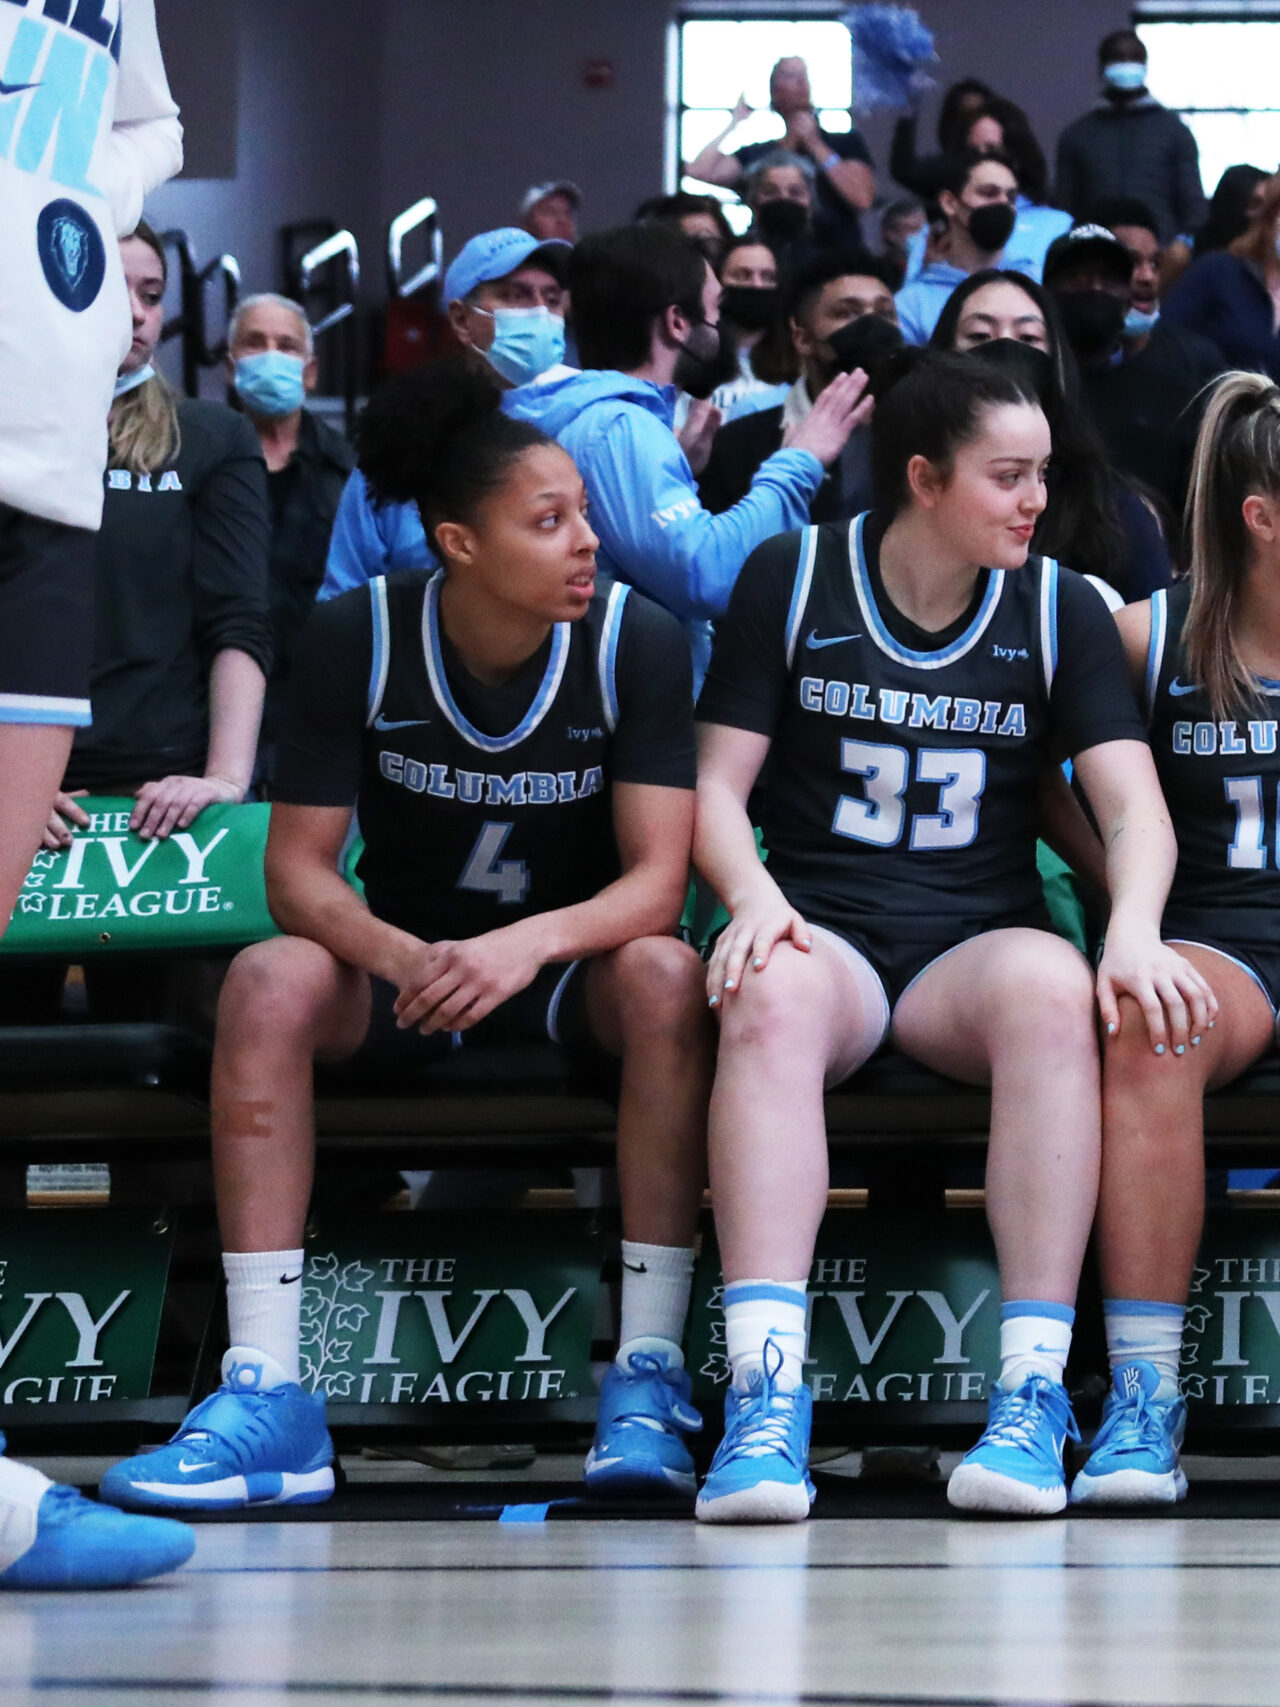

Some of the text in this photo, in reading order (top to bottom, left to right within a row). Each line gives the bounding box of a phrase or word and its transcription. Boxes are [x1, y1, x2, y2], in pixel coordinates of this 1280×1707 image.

[108, 469, 183, 493] BIA
[993, 644, 1017, 661] Ivy
[800, 676, 1027, 737] COLUMBIA
[567, 726, 591, 742] Ivy
[379, 750, 604, 806] COLUMBIA
[831, 737, 987, 851] 33
[53, 828, 230, 889] IVY
[456, 820, 531, 905] 4
[48, 886, 222, 921] LEAGUE
[379, 1258, 457, 1283] THE
[810, 1258, 867, 1283] HE
[0, 1289, 132, 1368] VY
[363, 1287, 578, 1364] IVY
[3, 1374, 118, 1404] GUE
[360, 1369, 566, 1403] LEAGUE
[809, 1372, 986, 1401] EAGUE
